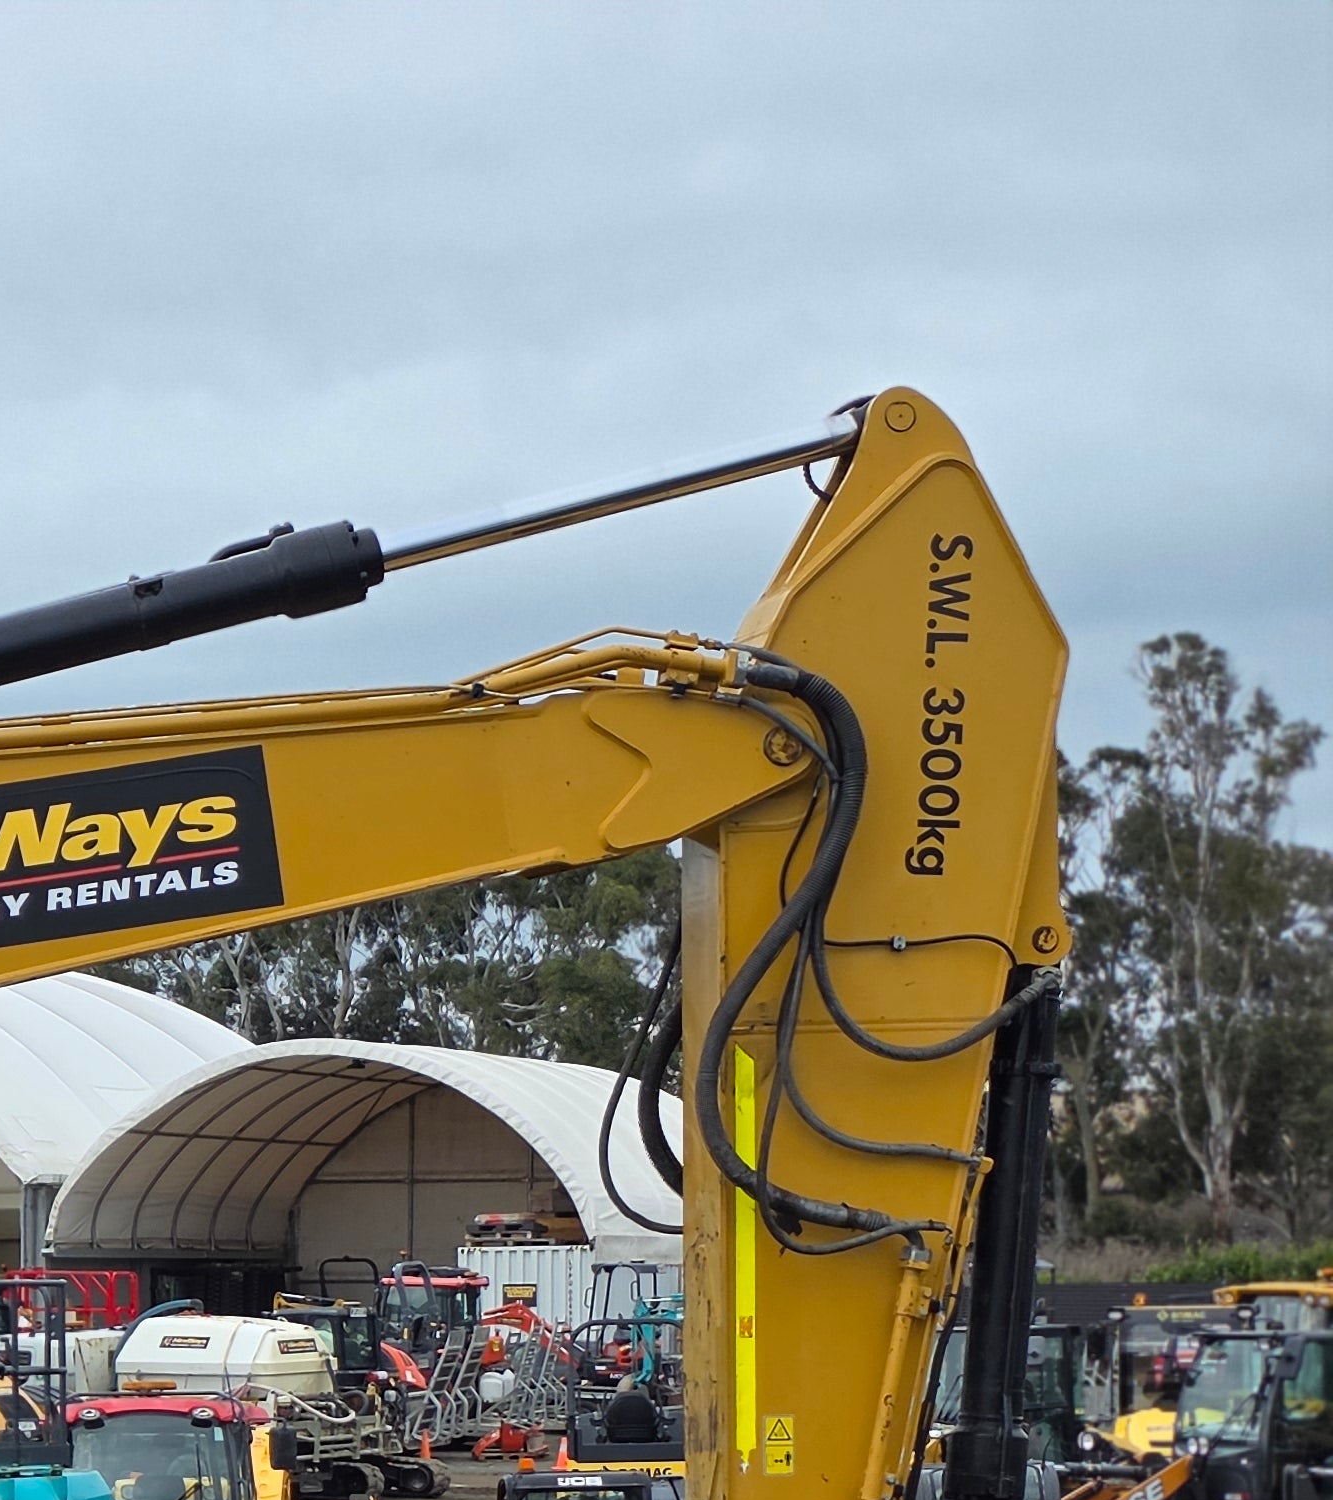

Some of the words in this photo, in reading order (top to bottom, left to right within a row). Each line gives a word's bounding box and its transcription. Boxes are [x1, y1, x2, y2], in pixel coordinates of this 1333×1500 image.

[925, 533, 974, 668] S.W.L.
[905, 686, 965, 876] 3500kg
[47, 861, 240, 912] RENTALS
[558, 1476, 602, 1486] JCB
